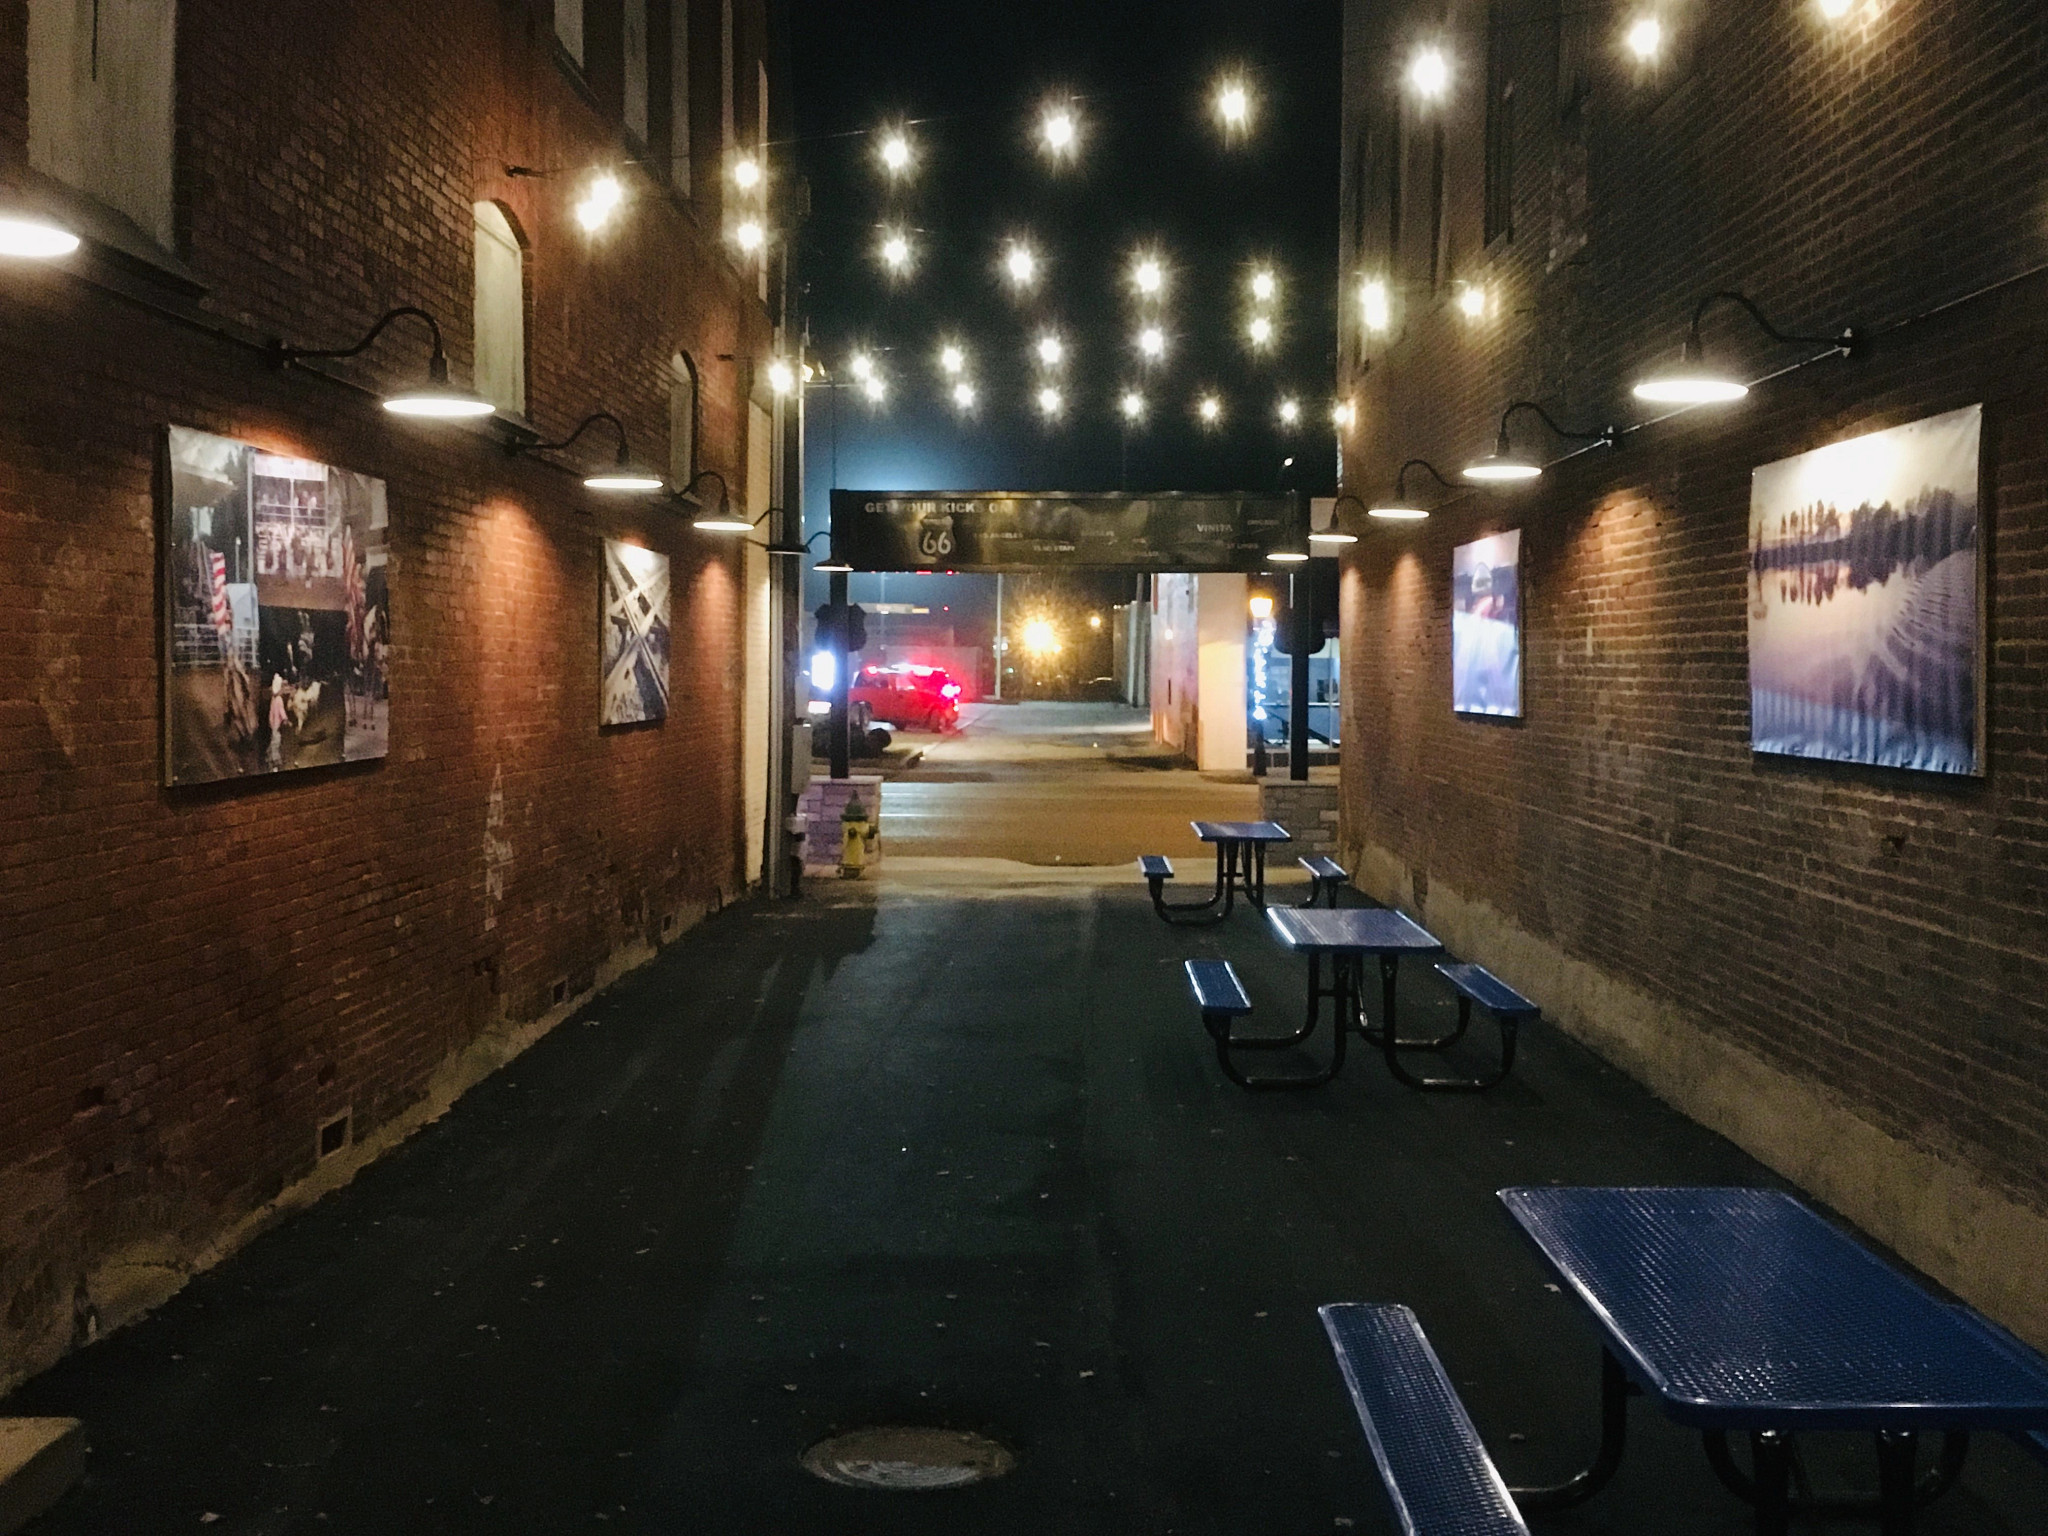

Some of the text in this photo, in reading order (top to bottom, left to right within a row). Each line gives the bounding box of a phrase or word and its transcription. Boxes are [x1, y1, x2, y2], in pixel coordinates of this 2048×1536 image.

[865, 502, 897, 514] GET
[941, 502, 984, 513] KICKS
[1196, 523, 1234, 533] VINITA
[922, 531, 951, 555] 66
